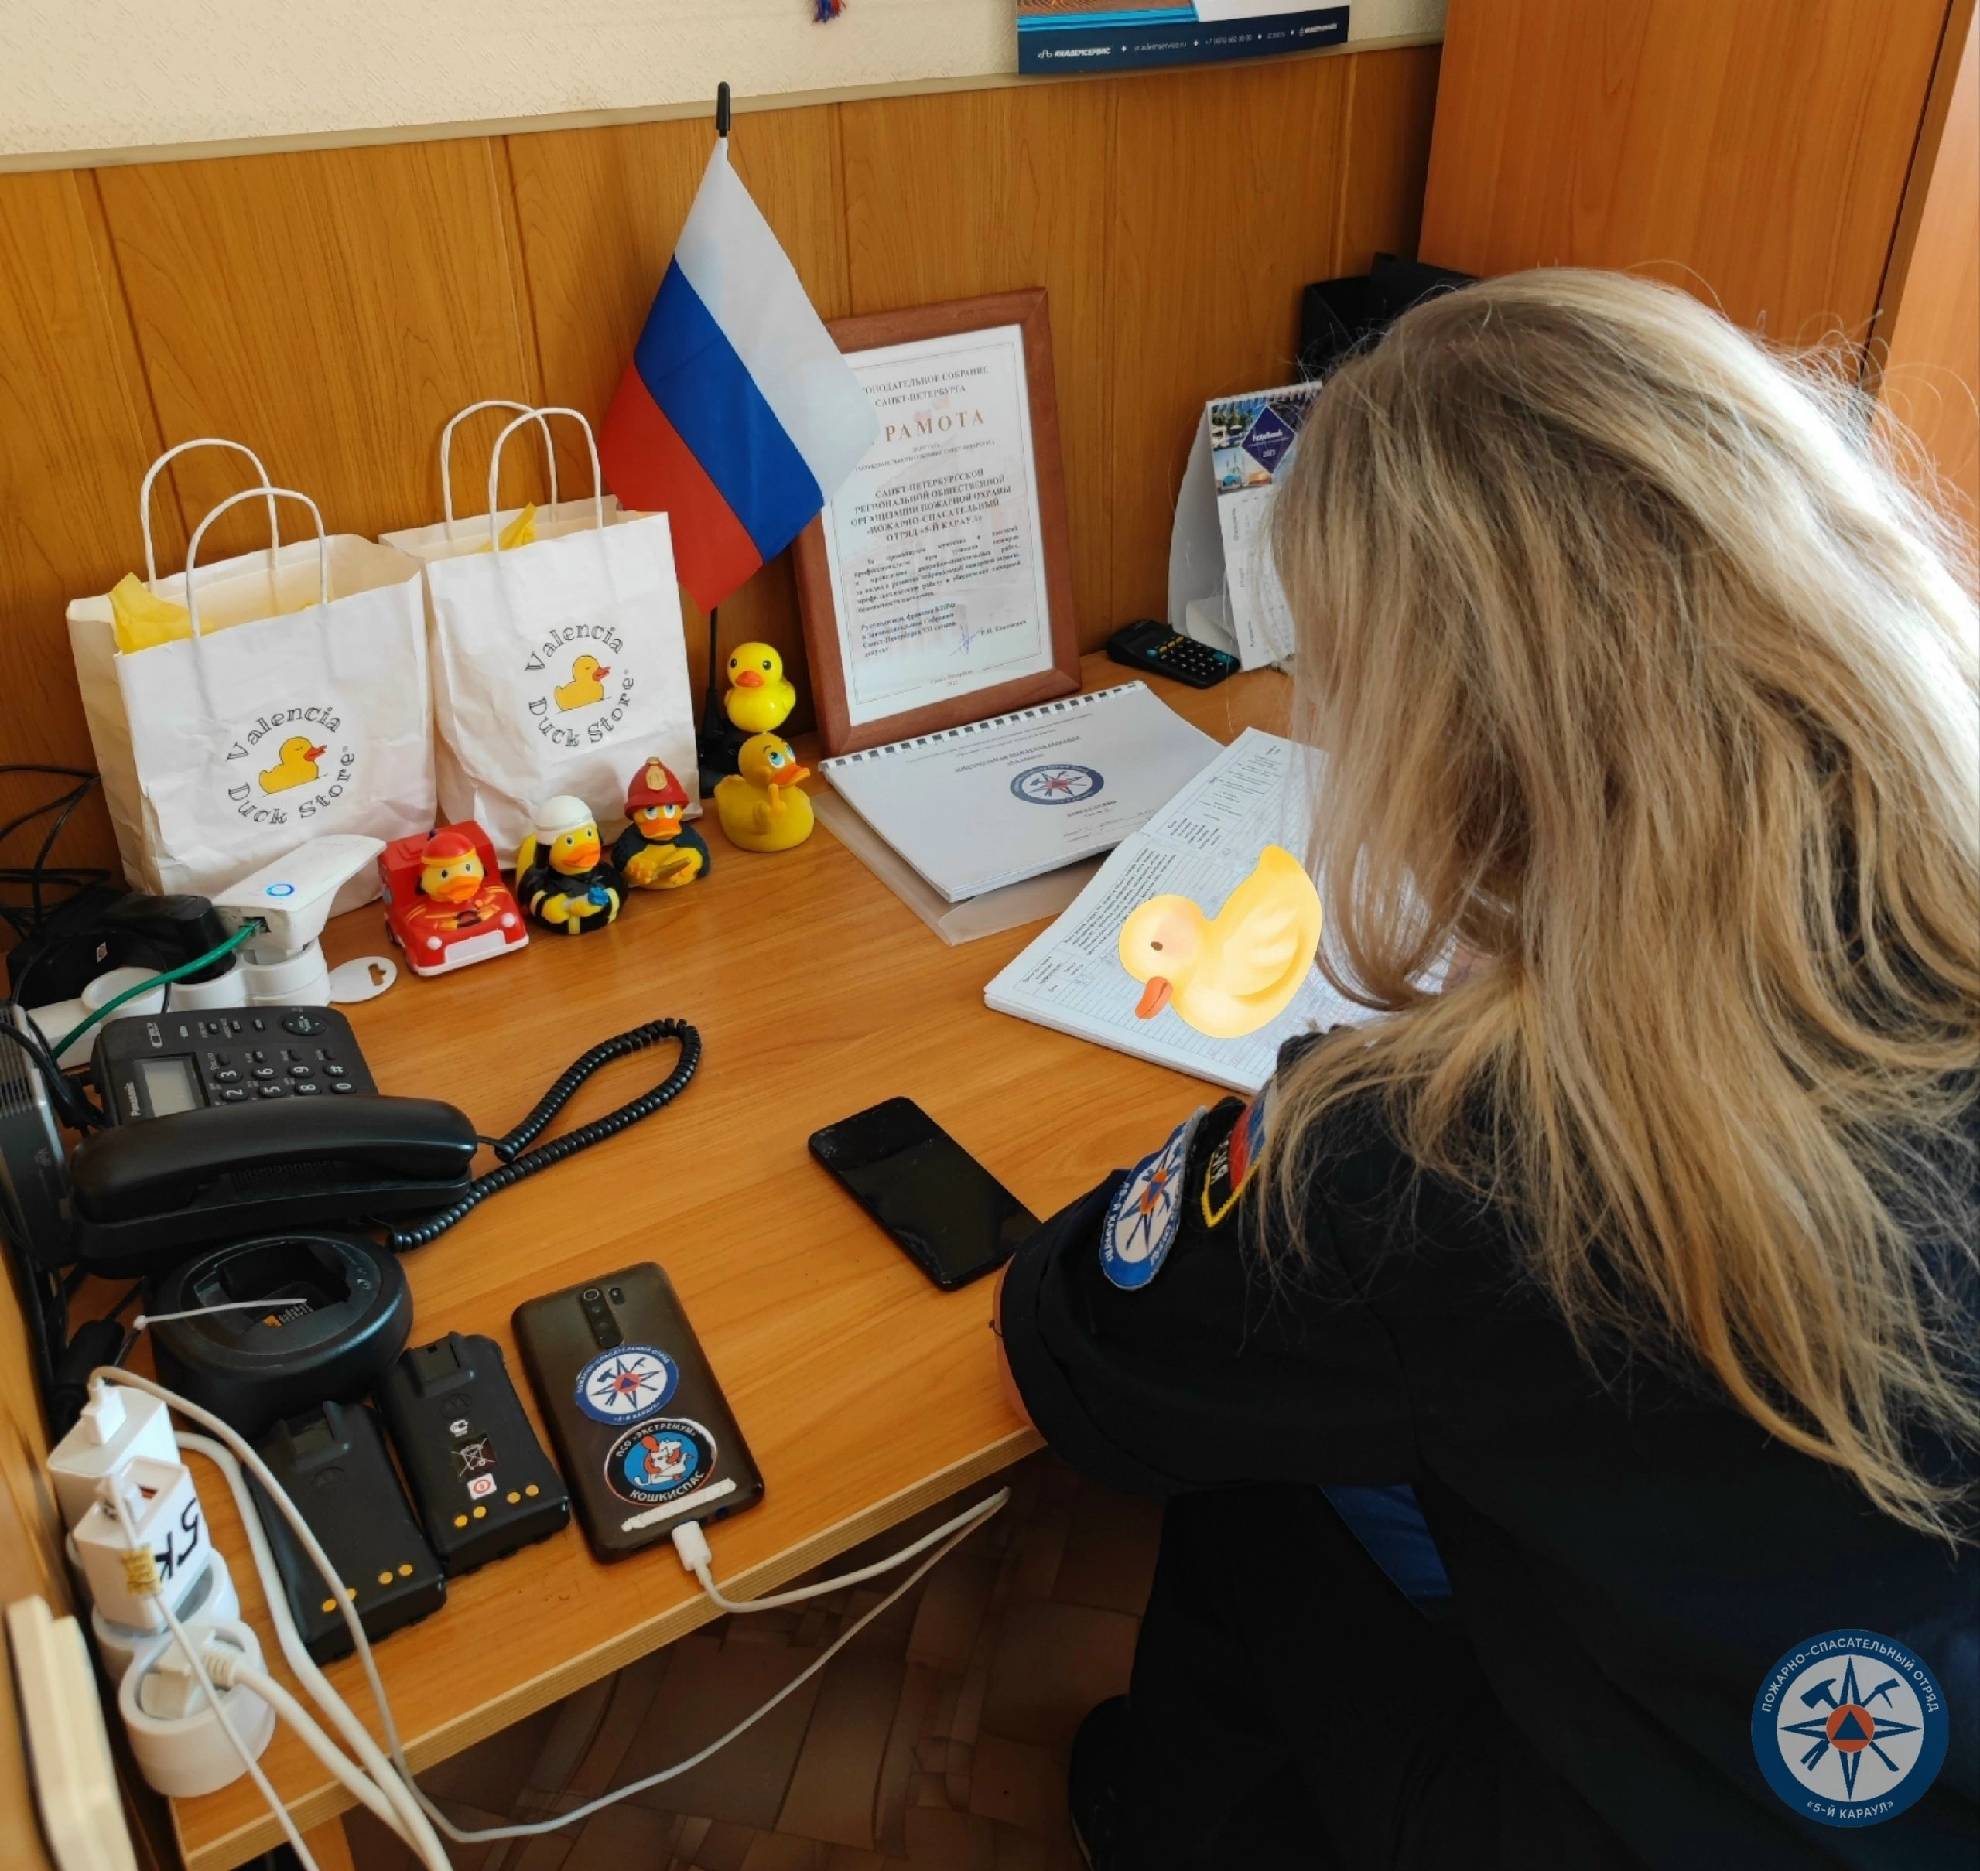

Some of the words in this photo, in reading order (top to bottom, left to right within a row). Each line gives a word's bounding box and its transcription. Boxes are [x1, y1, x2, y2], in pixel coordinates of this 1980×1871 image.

[883, 408, 985, 443] РАМОТА
[524, 623, 624, 671] Valencia
[527, 696, 581, 748] Duck
[226, 705, 341, 761] Valencia
[227, 782, 288, 825] Duck
[220, 1069, 237, 1079] 3
[257, 1067, 274, 1076] 6
[293, 1065, 310, 1074] 9
[226, 1088, 244, 1098] 2
[264, 1085, 281, 1094] 5
[300, 1083, 316, 1092] 8
[630, 1469, 704, 1502] КОШКИСПАС
